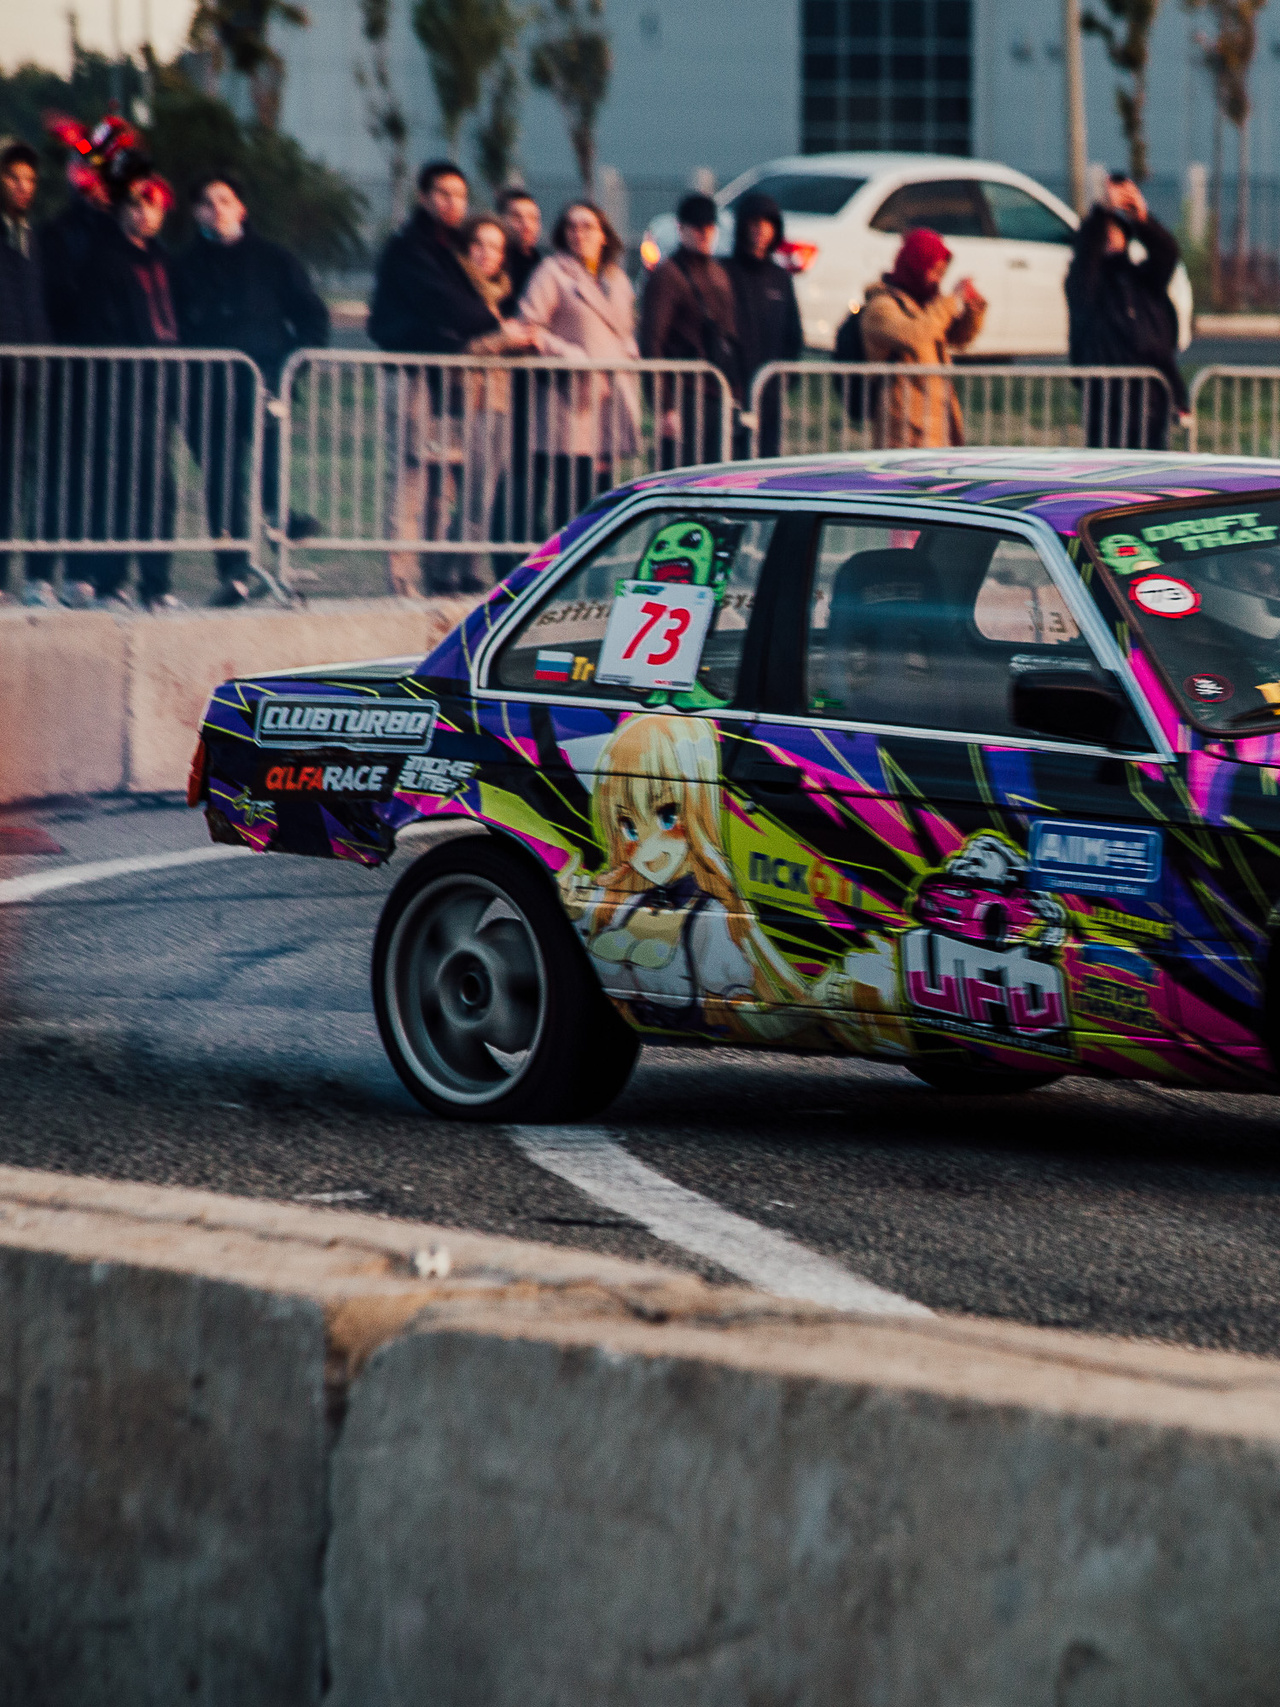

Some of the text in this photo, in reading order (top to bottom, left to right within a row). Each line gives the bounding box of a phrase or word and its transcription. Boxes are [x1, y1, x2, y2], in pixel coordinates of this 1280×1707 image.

[1141, 513, 1261, 542] DRIFT
[621, 601, 692, 666] 73
[261, 706, 431, 737] CLUBTURBO
[901, 928, 1069, 1037] UFO
